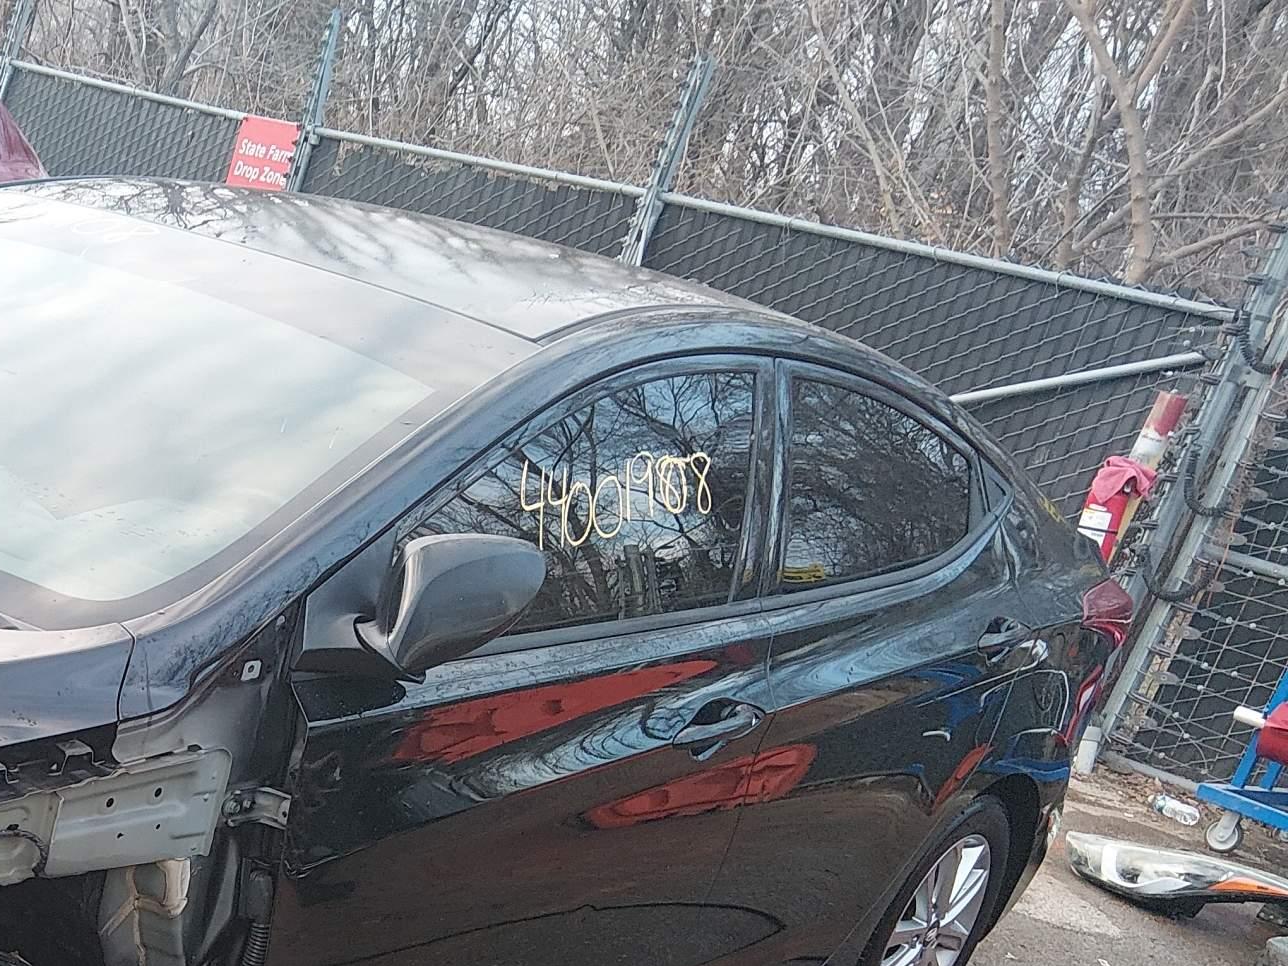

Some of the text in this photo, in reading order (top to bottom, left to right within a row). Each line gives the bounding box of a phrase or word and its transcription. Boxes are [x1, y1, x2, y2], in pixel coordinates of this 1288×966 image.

[238, 138, 266, 159] State
[233, 160, 287, 188] Drop Zone
